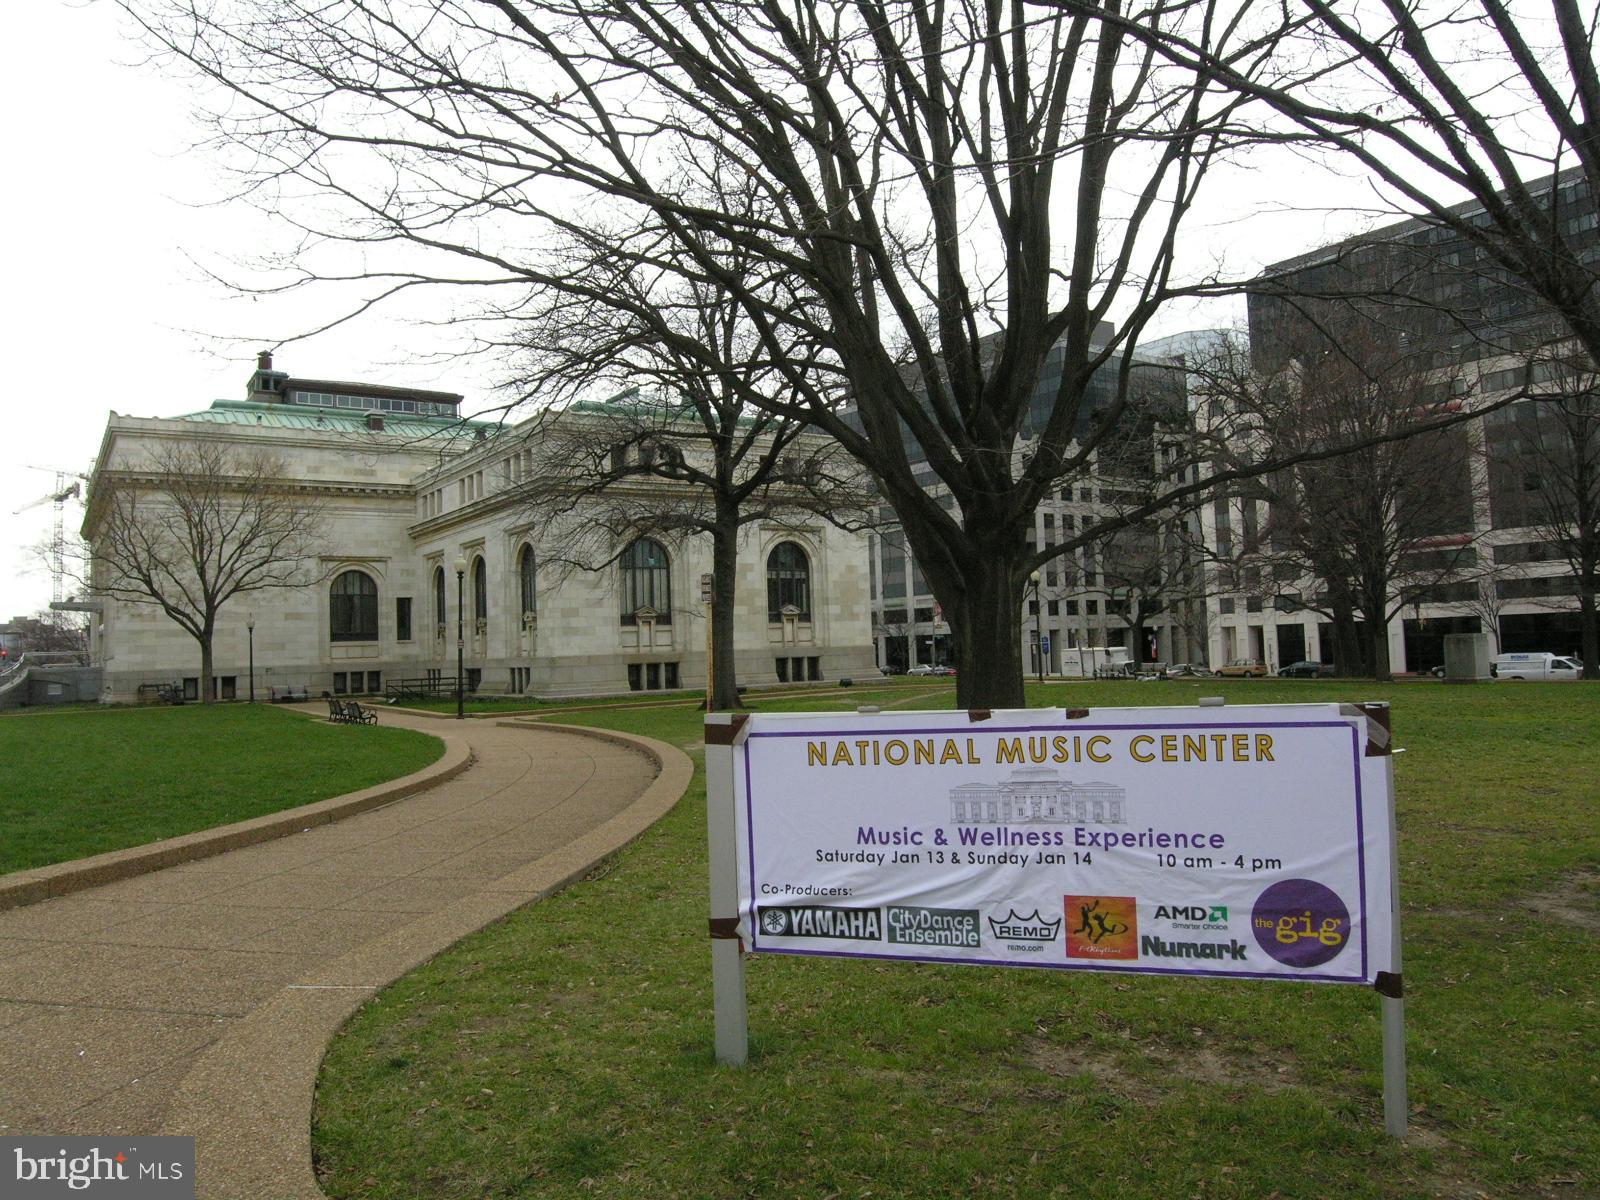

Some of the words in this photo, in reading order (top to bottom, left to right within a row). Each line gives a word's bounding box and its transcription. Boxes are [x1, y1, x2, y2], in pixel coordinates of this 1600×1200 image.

[808, 739, 980, 766] NATIONAL
[996, 735, 1112, 764] MUSIC
[1129, 734, 1275, 763] CENTER
[857, 826, 923, 846] Music
[934, 827, 948, 846] &
[958, 827, 1064, 847] Wellness
[1074, 827, 1225, 851] Experience
[816, 849, 885, 866] Saturday
[891, 851, 920, 864] Jan
[927, 851, 944, 864] 13
[951, 852, 961, 864] &
[968, 851, 1029, 867] Sunday
[1036, 852, 1066, 865] Jan
[1073, 852, 1092, 865] 14
[1157, 854, 1176, 867] 10
[1183, 856, 1213, 868] am
[1234, 855, 1244, 869] 4
[1252, 857, 1282, 872] pm
[761, 883, 853, 896] Co-Producers:
[790, 909, 880, 938] YAMAHA
[888, 908, 974, 930] CityDance
[1154, 906, 1207, 921] AMD
[895, 924, 979, 946] Ensemble
[999, 926, 1051, 937] REMO
[1172, 922, 1200, 930] Smarter
[1202, 923, 1228, 931] Choice
[1254, 917, 1273, 928] the
[1275, 911, 1342, 946] gig
[1141, 935, 1248, 960] Numark
